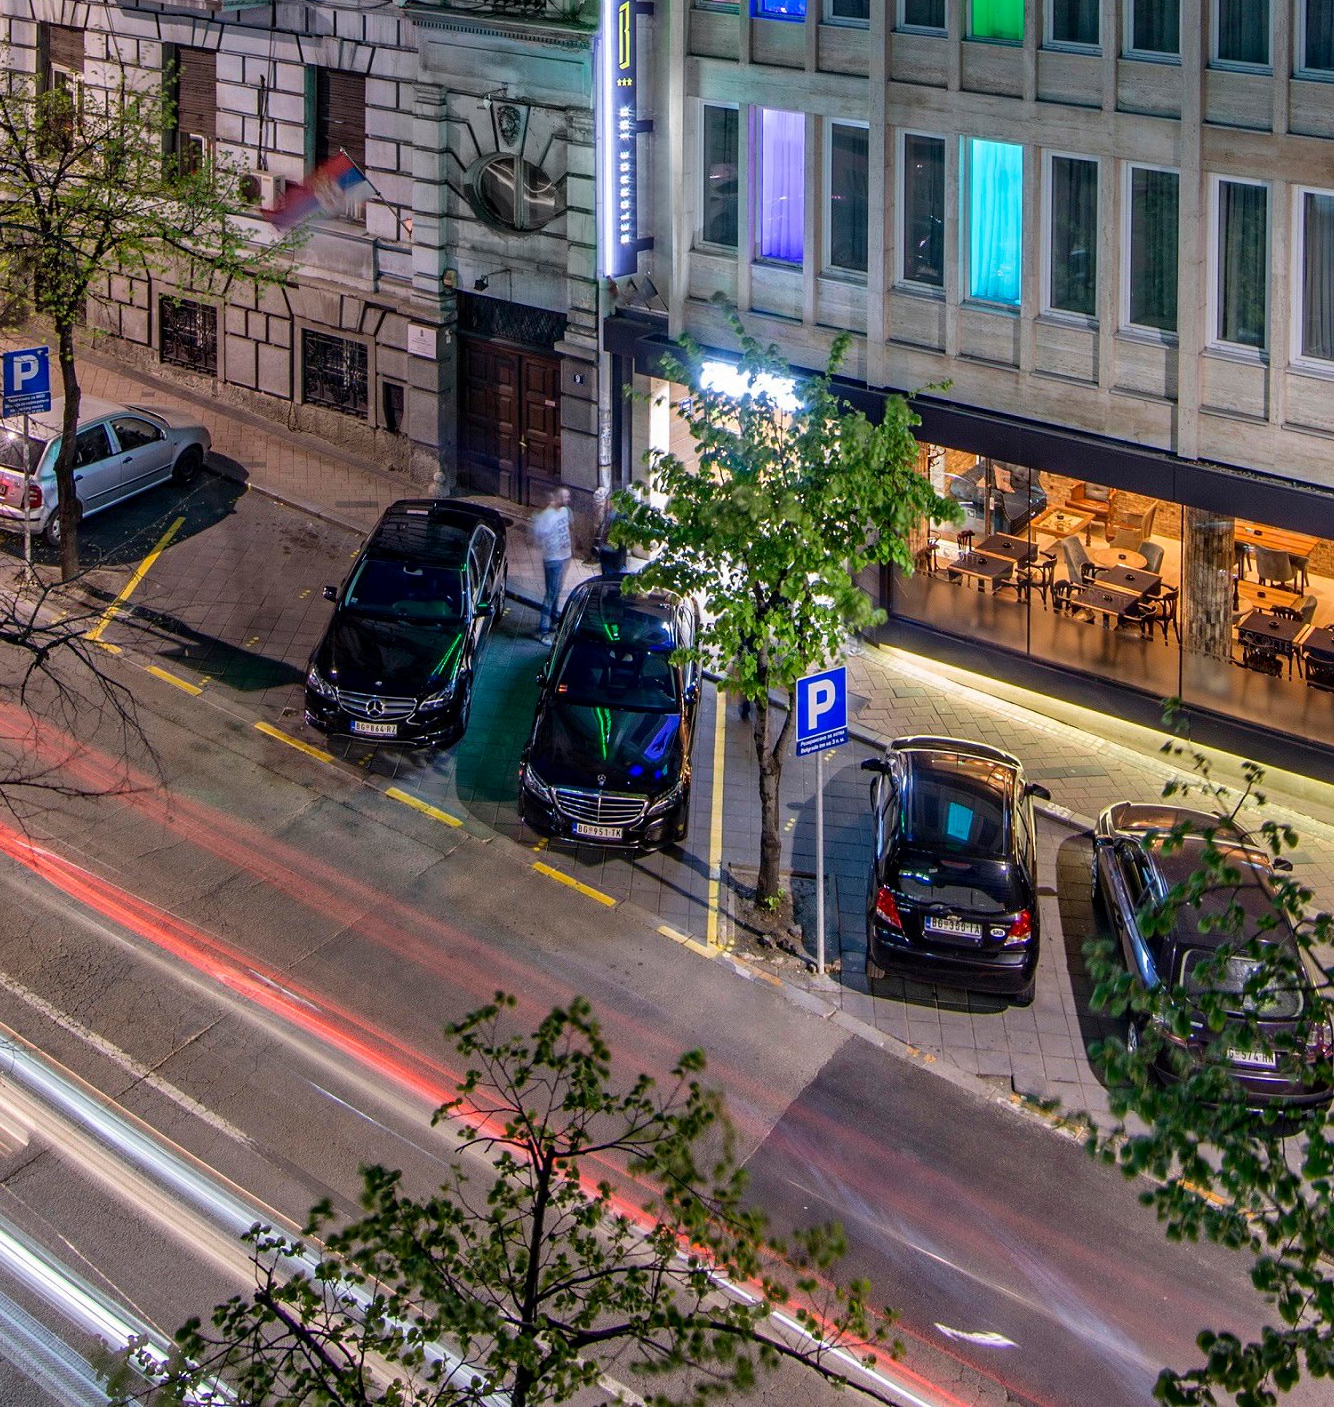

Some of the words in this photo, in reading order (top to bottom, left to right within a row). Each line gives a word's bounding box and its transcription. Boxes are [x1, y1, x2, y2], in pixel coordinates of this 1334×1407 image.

[620, 151, 629, 244] BELGRADE
[13, 354, 39, 391] P
[808, 679, 836, 730] P
[356, 723, 366, 731] BG
[579, 825, 588, 833] BG
